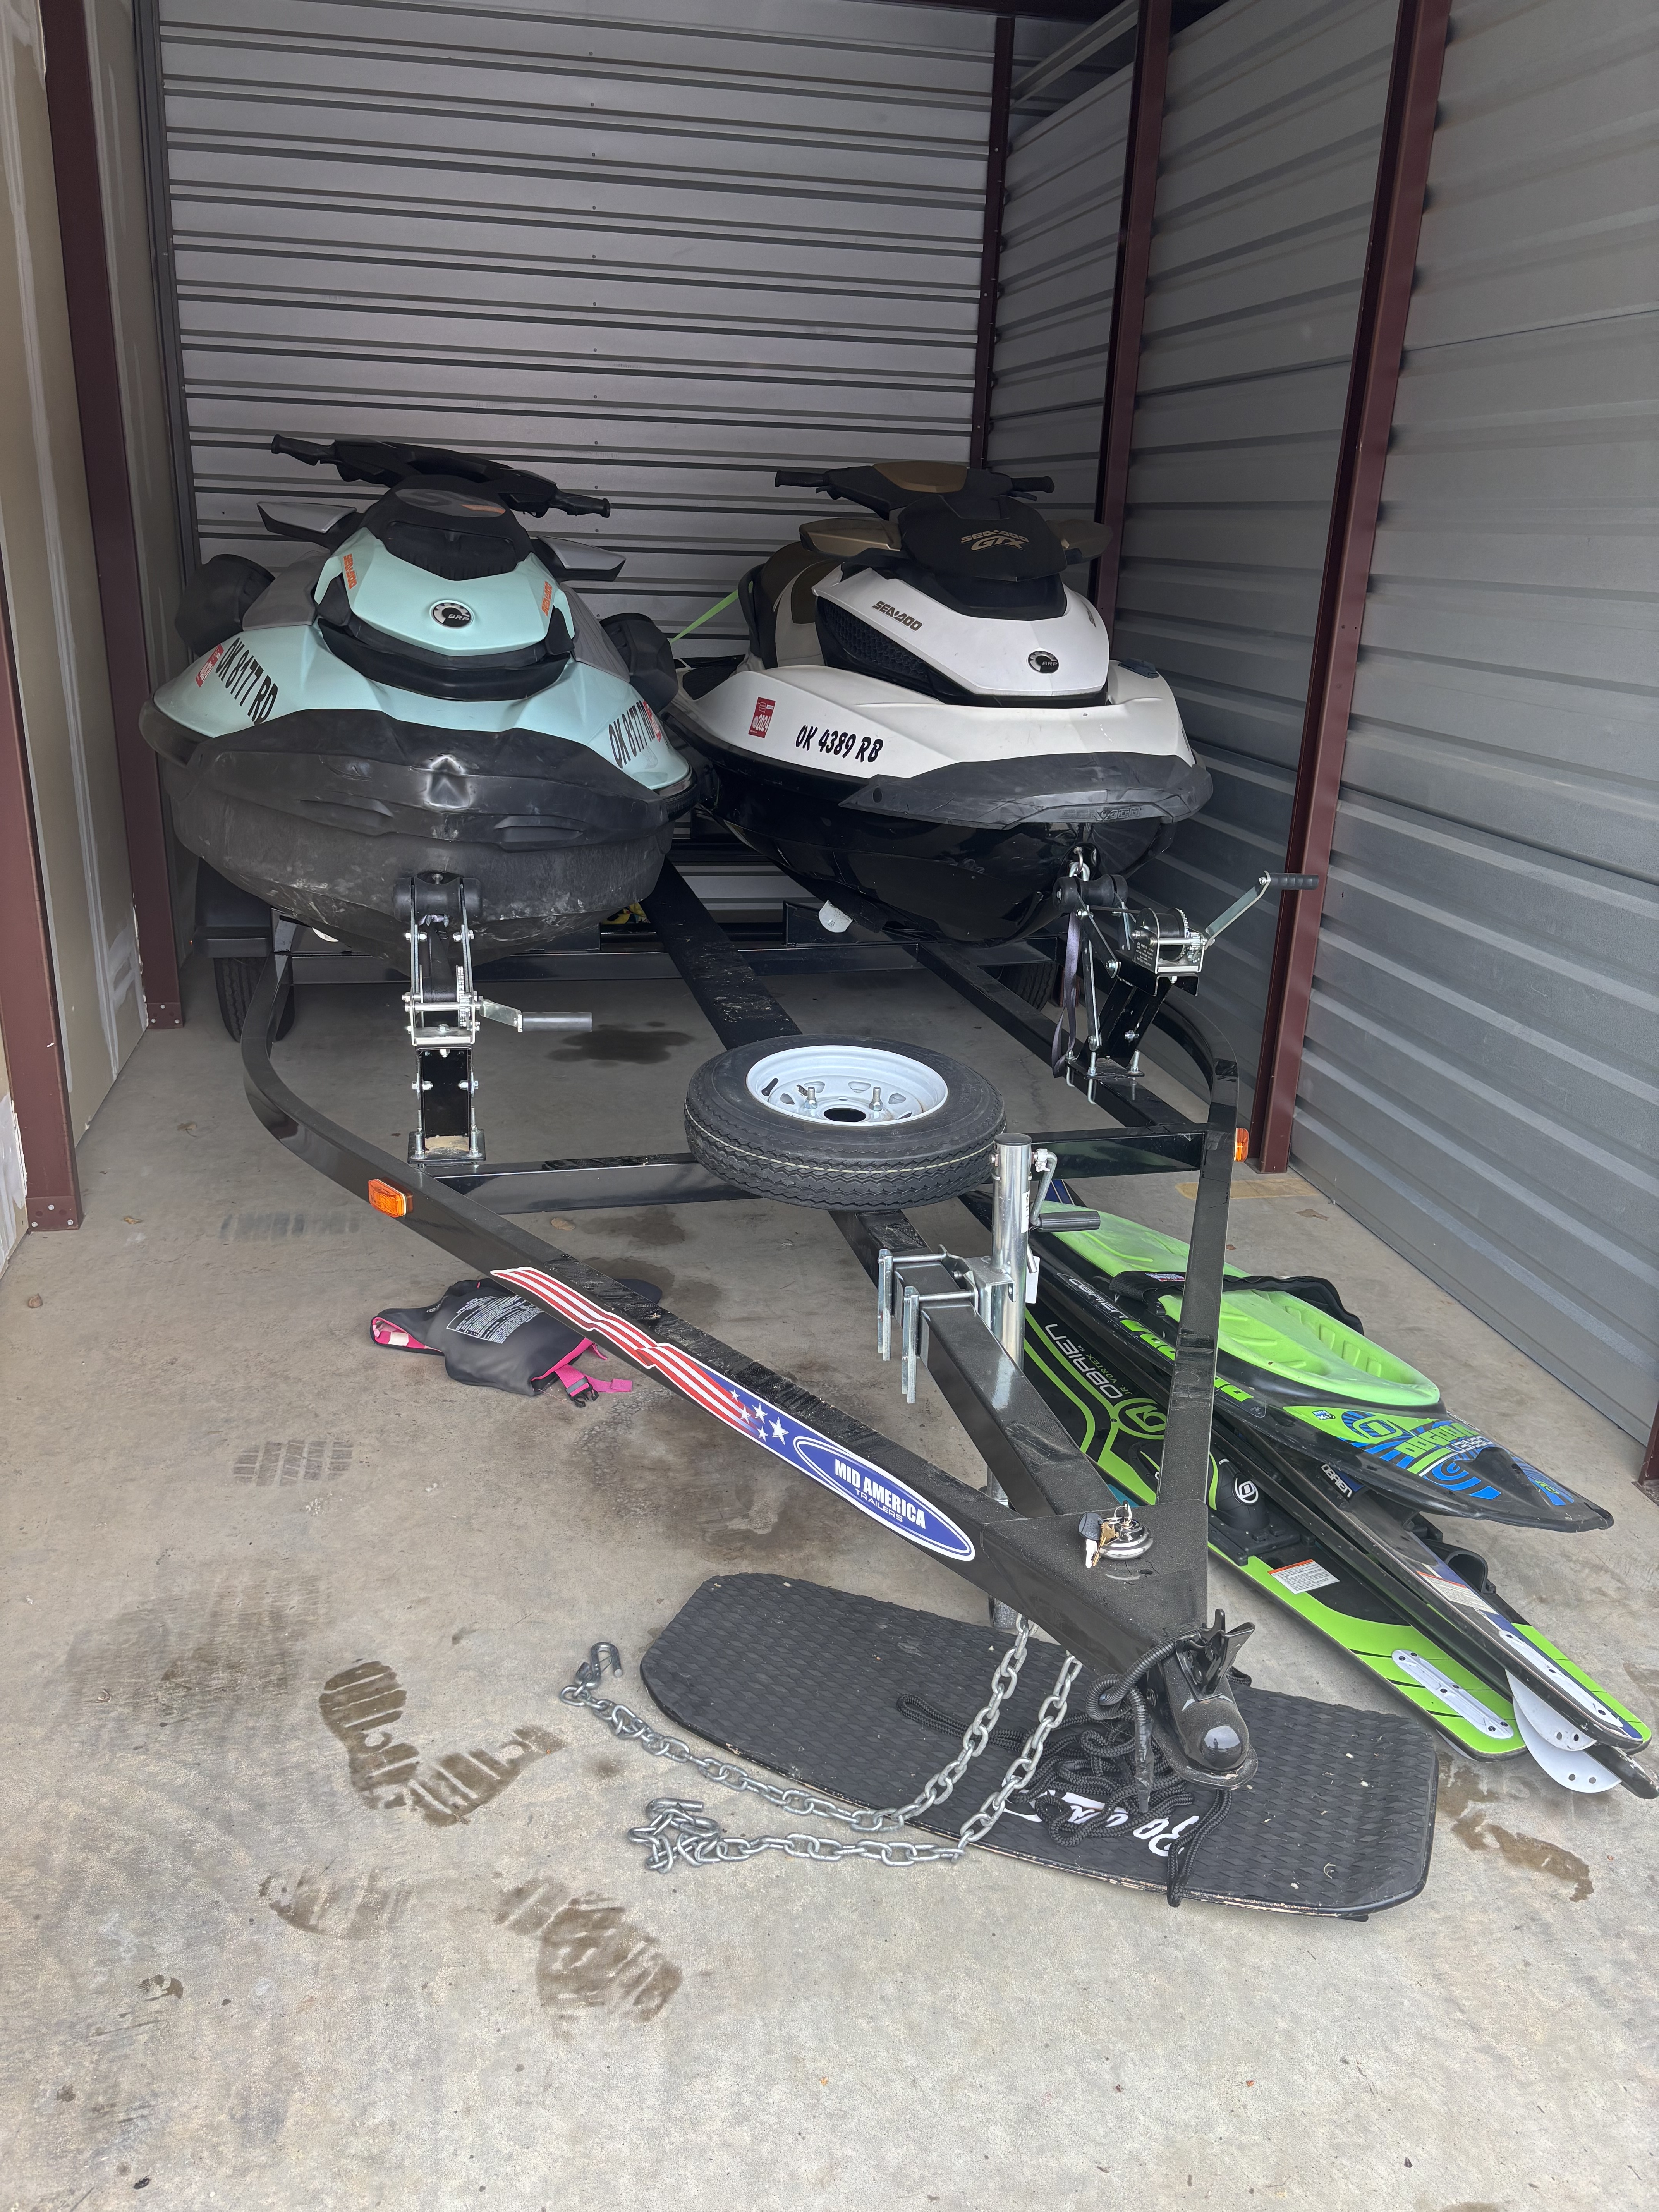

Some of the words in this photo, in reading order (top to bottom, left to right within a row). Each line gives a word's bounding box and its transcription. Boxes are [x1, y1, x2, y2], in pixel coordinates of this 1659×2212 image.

[971, 536, 1026, 550] GTX
[215, 637, 245, 682] OK
[225, 649, 264, 707] 8177
[247, 675, 278, 726] RD
[608, 718, 631, 769] OK
[622, 704, 648, 757] 8177
[755, 714, 771, 733] 2024
[795, 725, 818, 751] OK
[818, 728, 856, 759] 4389
[855, 736, 884, 763] RB
[1069, 1278, 1129, 1319] OBRIEN
[1045, 1324, 1123, 1399] OBRIEN
[1085, 1353, 1117, 1384] VORTEX
[1120, 1385, 1133, 1395] JR.
[1445, 1436, 1493, 1453] OBRIEN
[835, 1458, 860, 1489] MID
[863, 1477, 926, 1530] AMERICA
[1321, 1464, 1353, 1498] OBRIEN
[855, 1488, 903, 1522] TRAILERS
